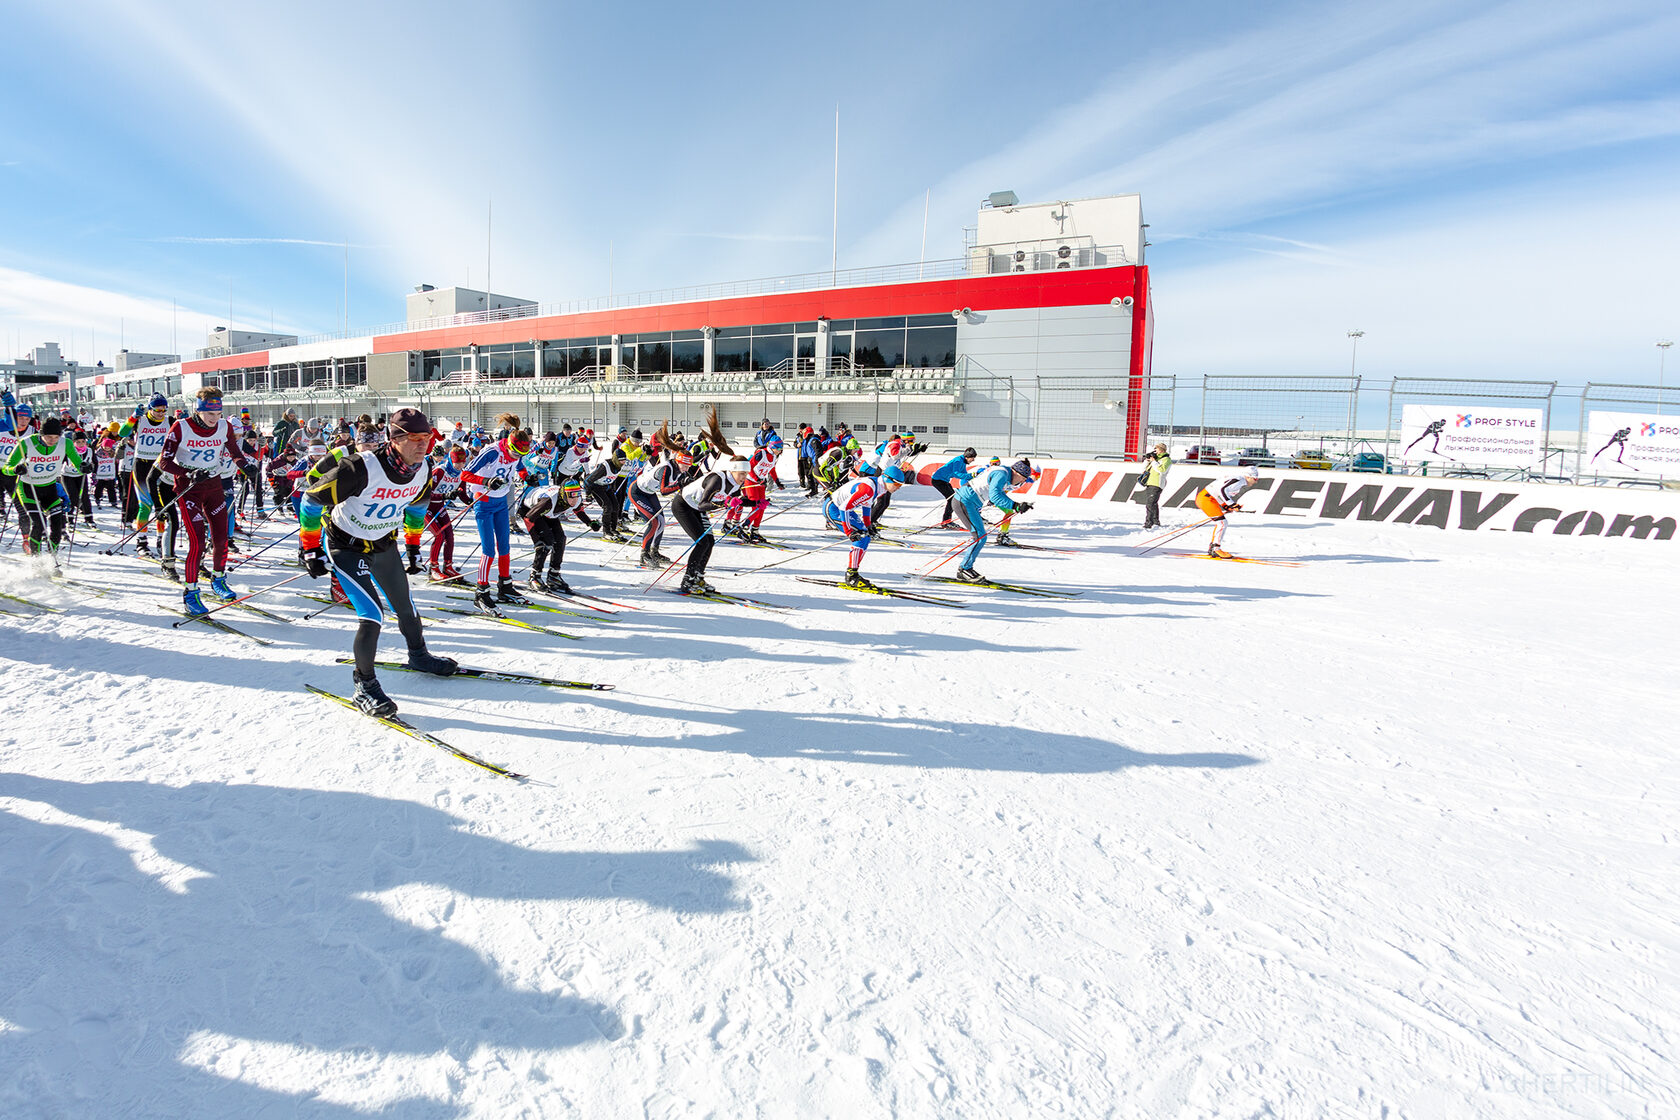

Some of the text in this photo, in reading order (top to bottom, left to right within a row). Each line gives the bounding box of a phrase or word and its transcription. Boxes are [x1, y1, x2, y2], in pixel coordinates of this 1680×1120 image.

[1475, 417, 1536, 429] PROF STYLE
[1, 436, 18, 445] ДЮС
[139, 434, 165, 447] 104
[187, 439, 222, 449] ДЮСШ
[1446, 435, 1534, 447] Профессиональная
[189, 449, 216, 463] 78
[1444, 445, 1534, 456] лыжная экипировка
[30, 455, 60, 464] ДЮСШ
[33, 462, 56, 473] 66
[101, 464, 112, 472] 21
[371, 486, 420, 500] ДЮСШ
[211, 500, 227, 516] LUKO
[1110, 473, 1677, 540] RACEWAYcom
[478, 672, 543, 686] FSCHER
